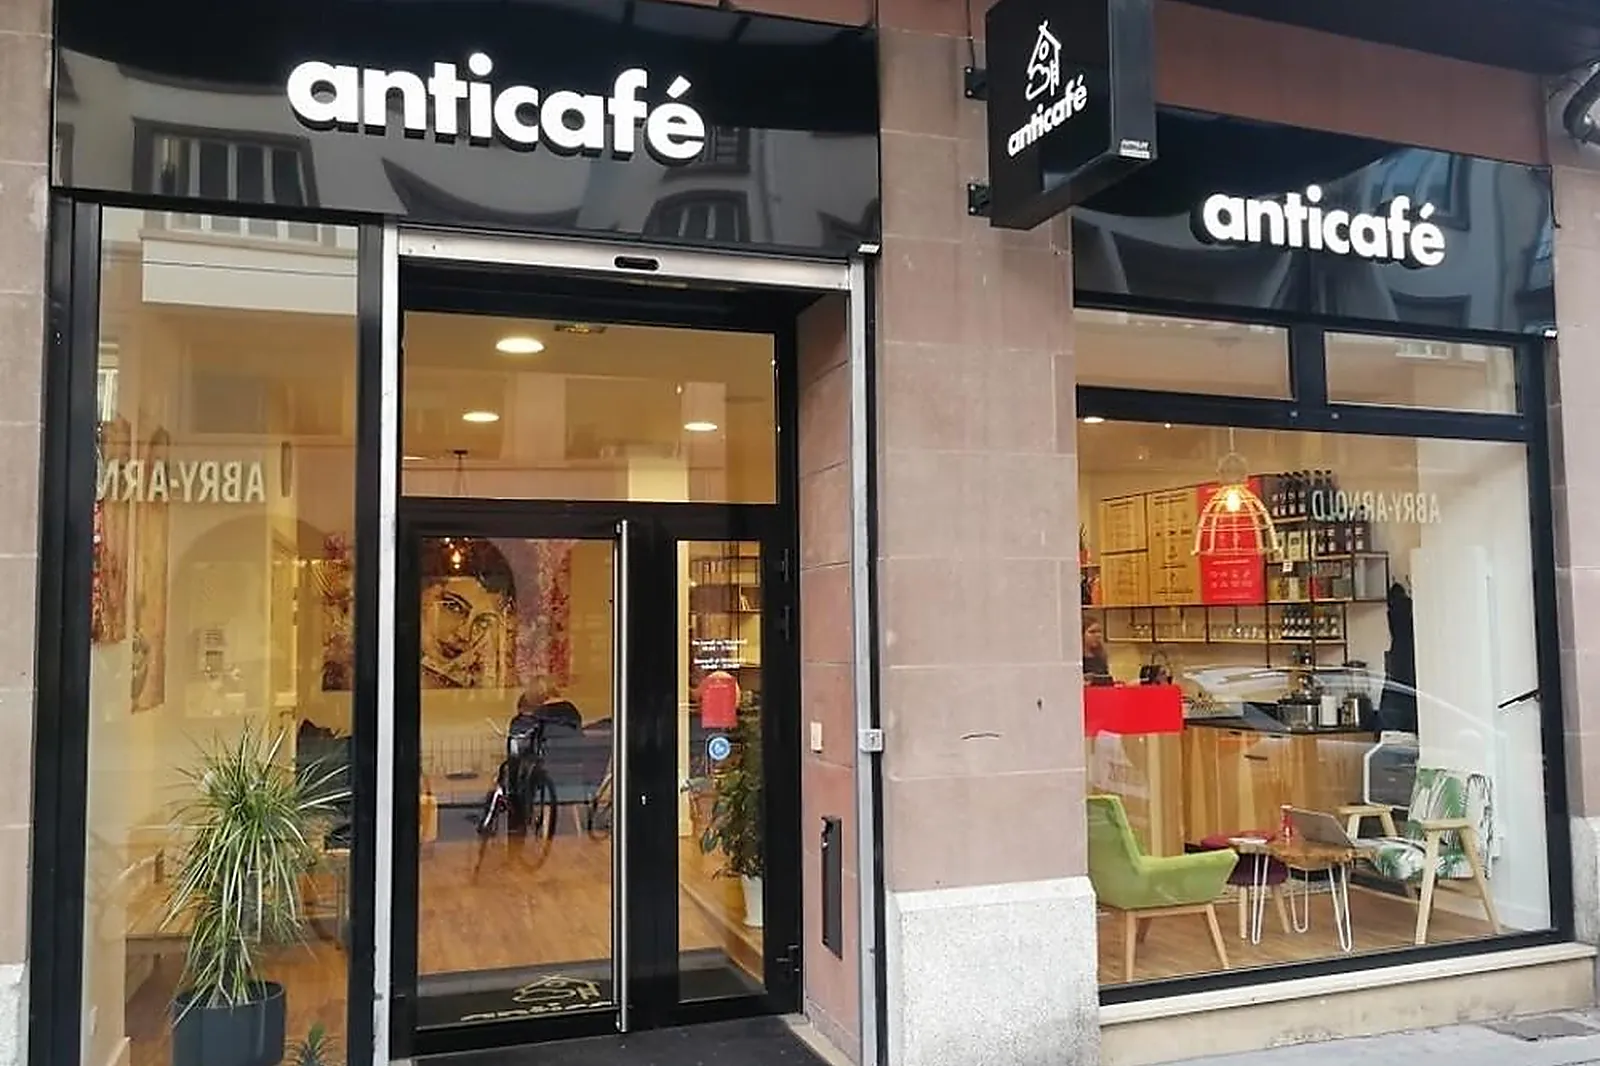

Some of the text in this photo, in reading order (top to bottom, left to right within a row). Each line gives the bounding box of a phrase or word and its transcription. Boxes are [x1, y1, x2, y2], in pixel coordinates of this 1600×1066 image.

[287, 52, 705, 159] anticafé
[1008, 74, 1088, 157] anticafé
[1203, 184, 1445, 266] anticafé
